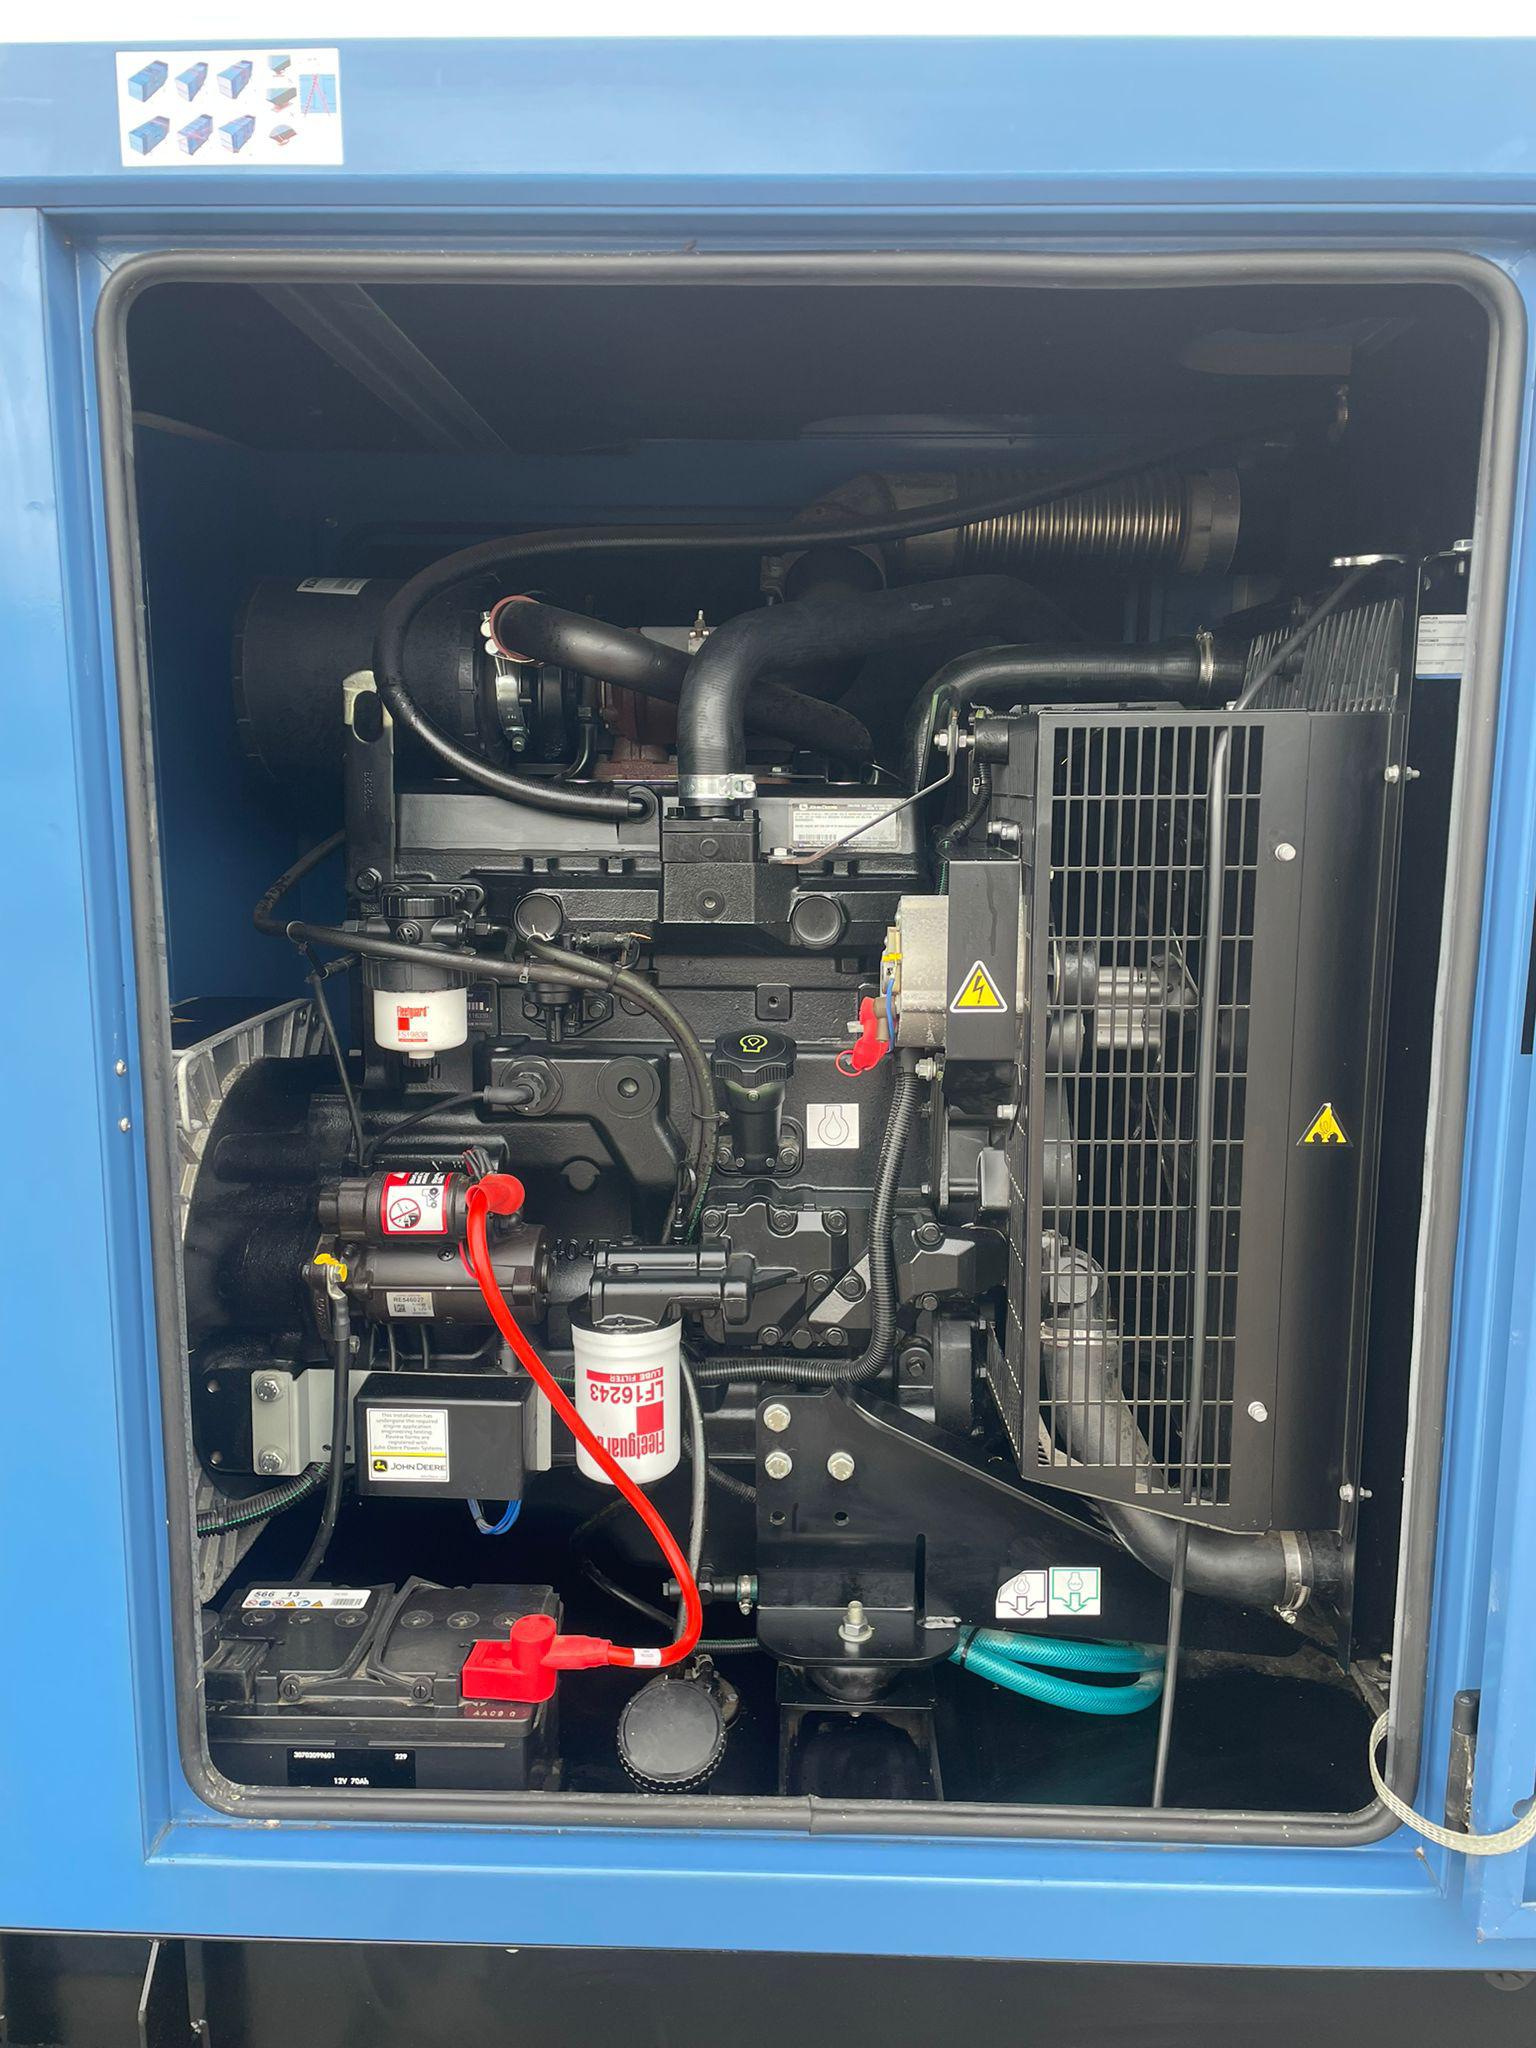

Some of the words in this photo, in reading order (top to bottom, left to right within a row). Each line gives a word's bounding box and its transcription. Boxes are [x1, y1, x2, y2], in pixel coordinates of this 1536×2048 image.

[609, 1374, 636, 1382] FILTER
[639, 1370, 661, 1380] LUBE
[590, 1380, 664, 1404] LF16243
[334, 1777, 347, 1785] 12V
